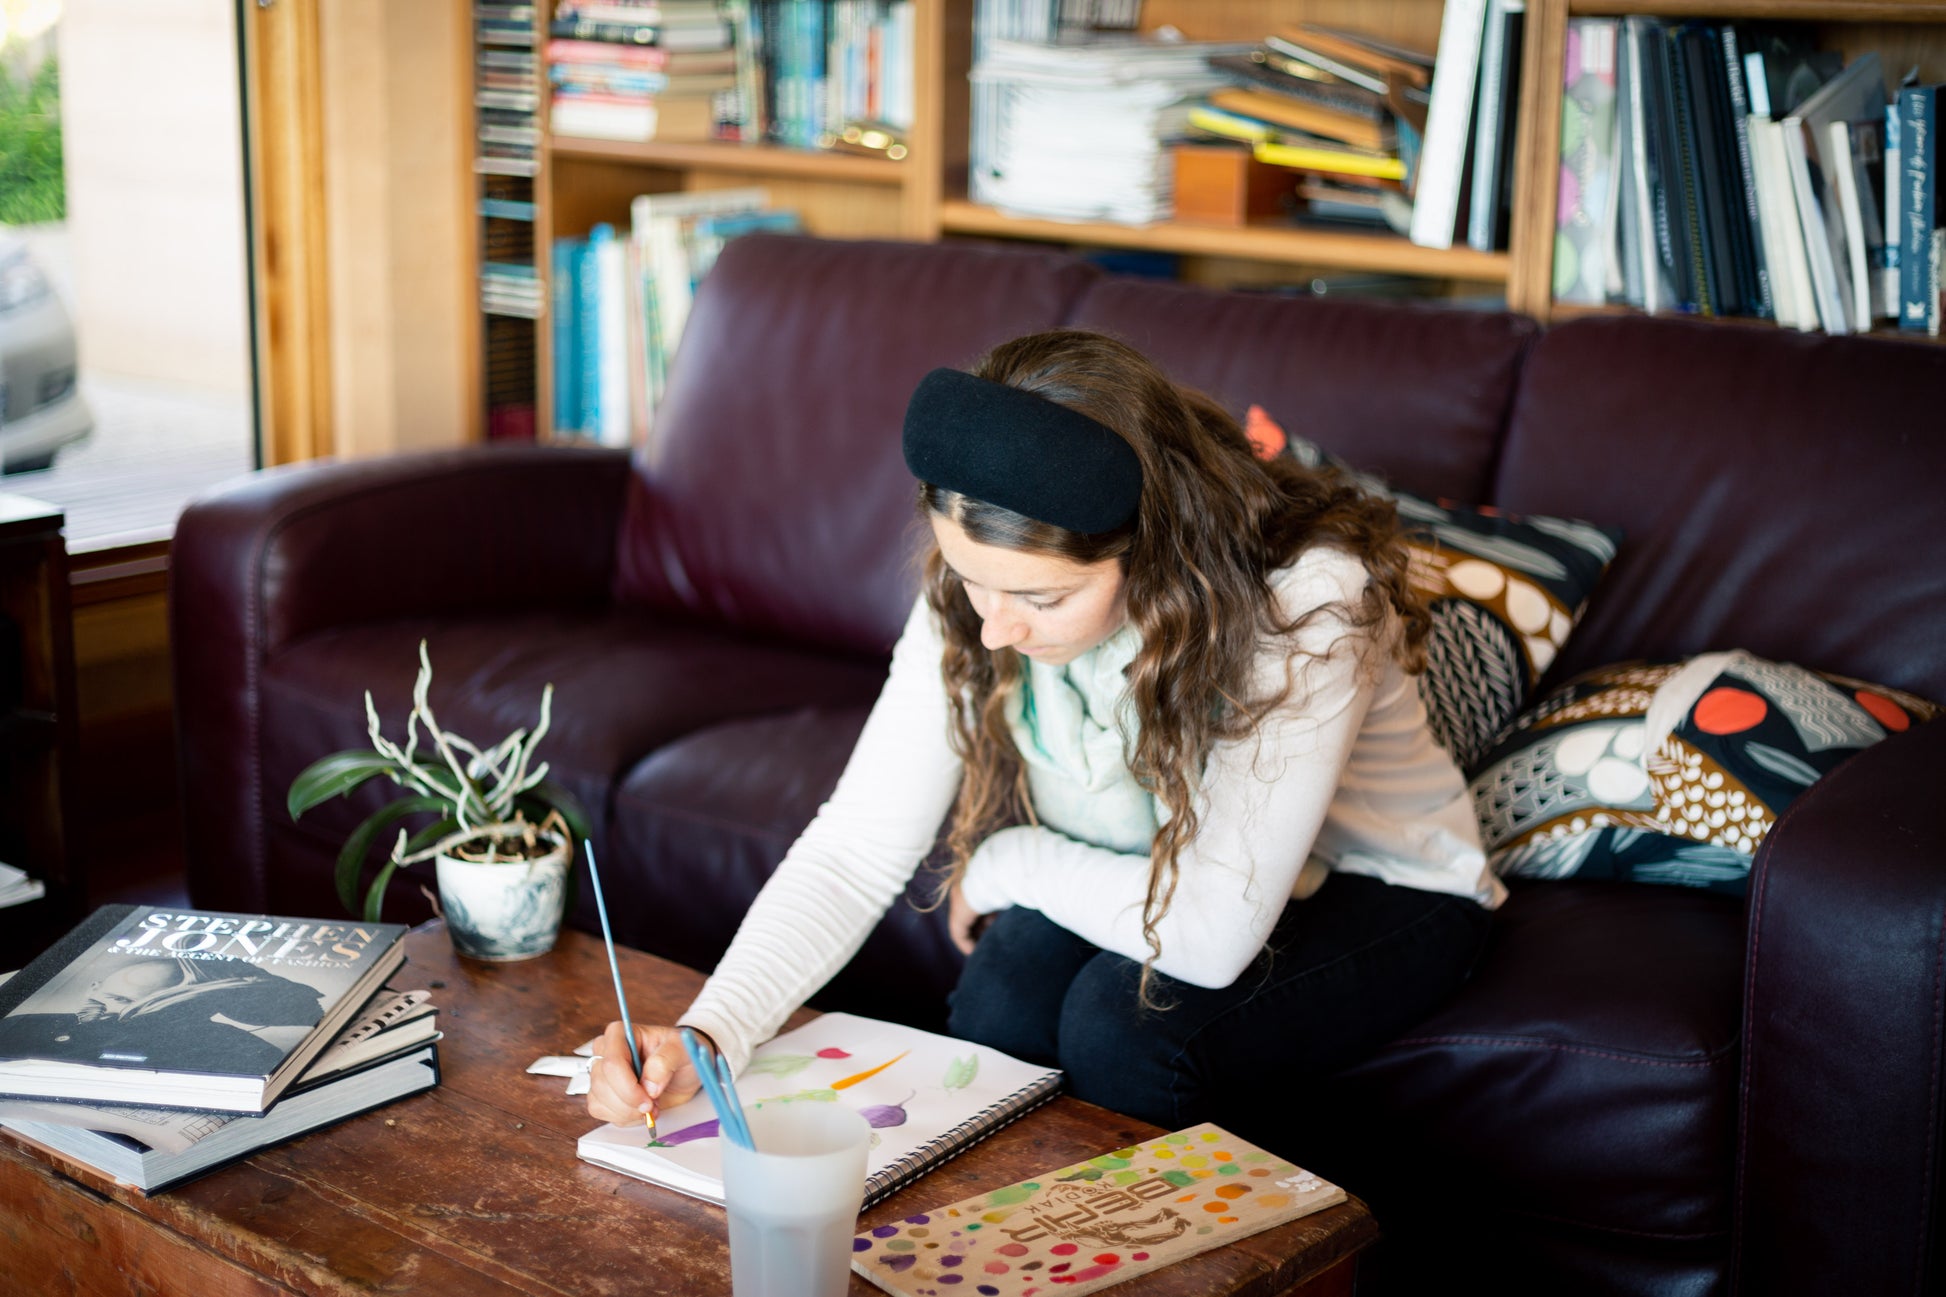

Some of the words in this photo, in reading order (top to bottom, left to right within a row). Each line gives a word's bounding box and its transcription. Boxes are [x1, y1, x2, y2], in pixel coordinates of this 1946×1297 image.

[116, 927, 362, 962] JONES
[138, 913, 384, 944] STEPHEN
[125, 947, 161, 957] THE
[268, 957, 352, 969] FASHION
[999, 1177, 1181, 1242] BEAR
[1024, 1181, 1112, 1214] KODIAK
